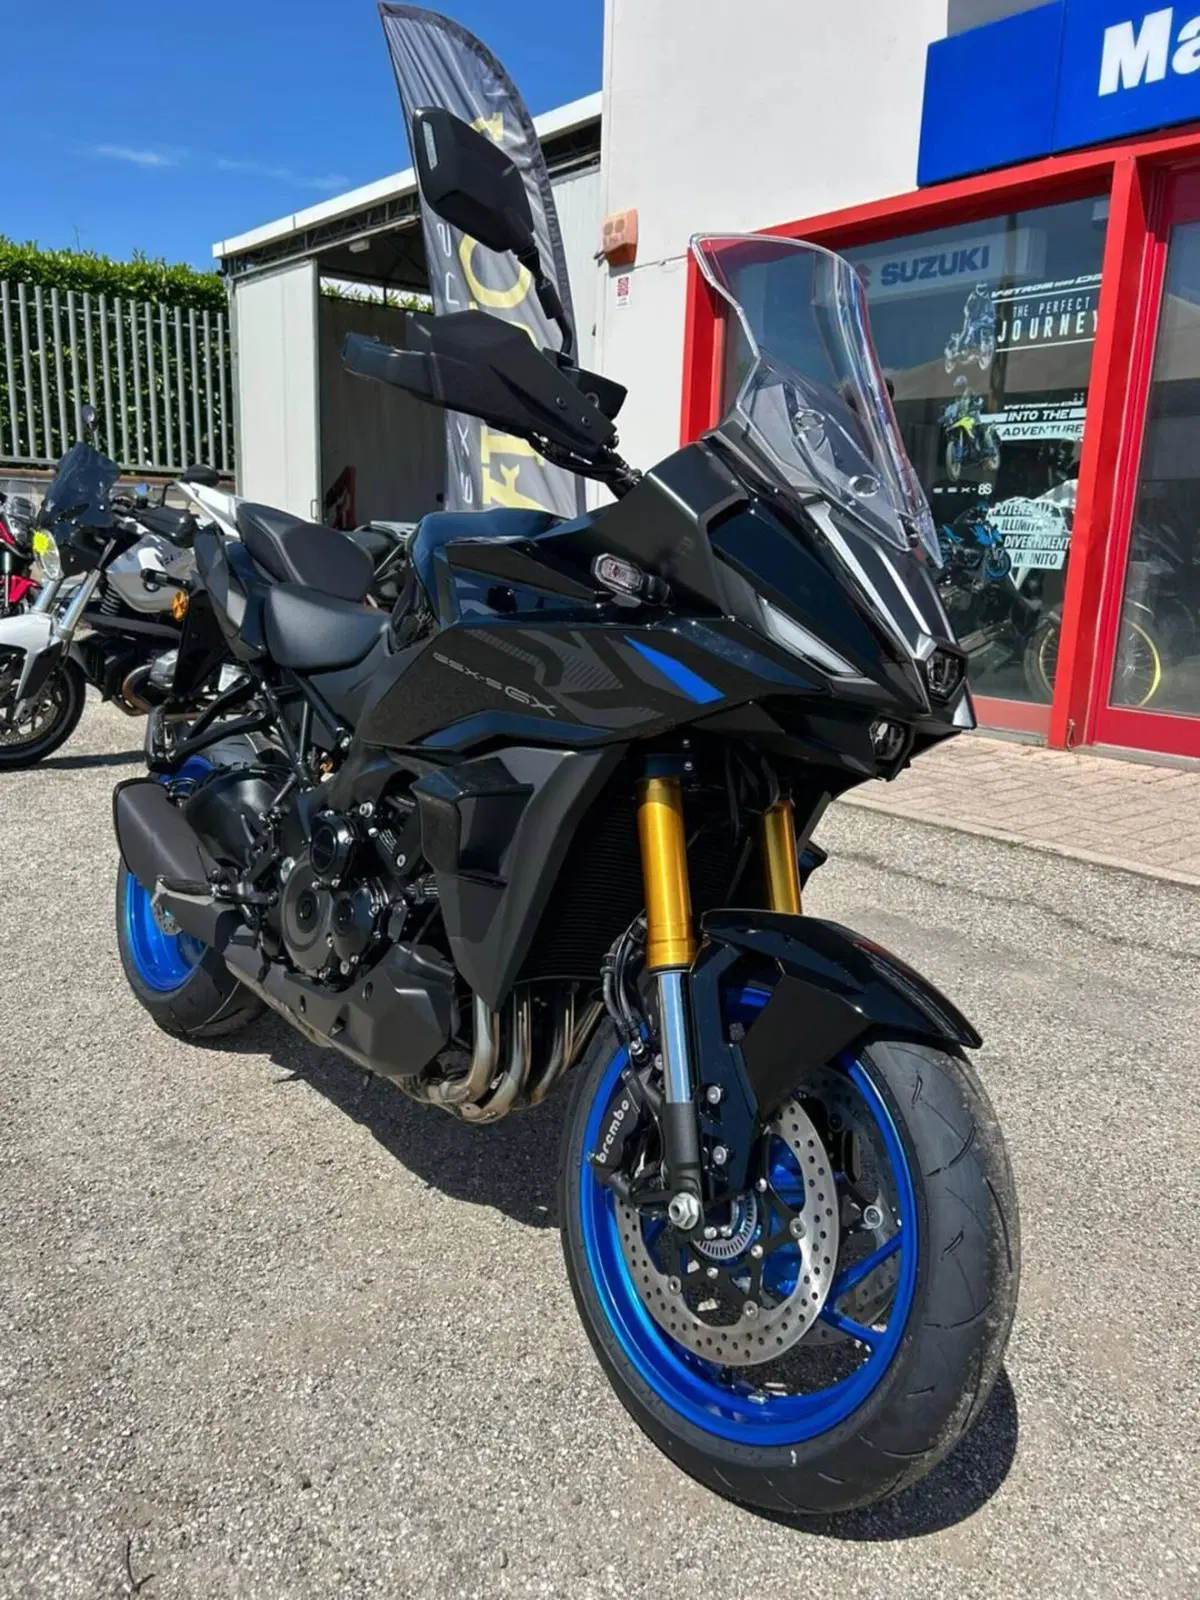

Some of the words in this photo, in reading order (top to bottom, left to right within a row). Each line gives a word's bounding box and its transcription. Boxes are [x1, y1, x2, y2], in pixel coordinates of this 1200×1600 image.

[881, 245, 990, 286] SUZUKI
[1013, 304, 1029, 318] THE
[1038, 296, 1091, 315] PERFECT
[1007, 411, 1039, 421] INTO
[1042, 408, 1070, 420] THE
[595, 1100, 629, 1163] brembo
